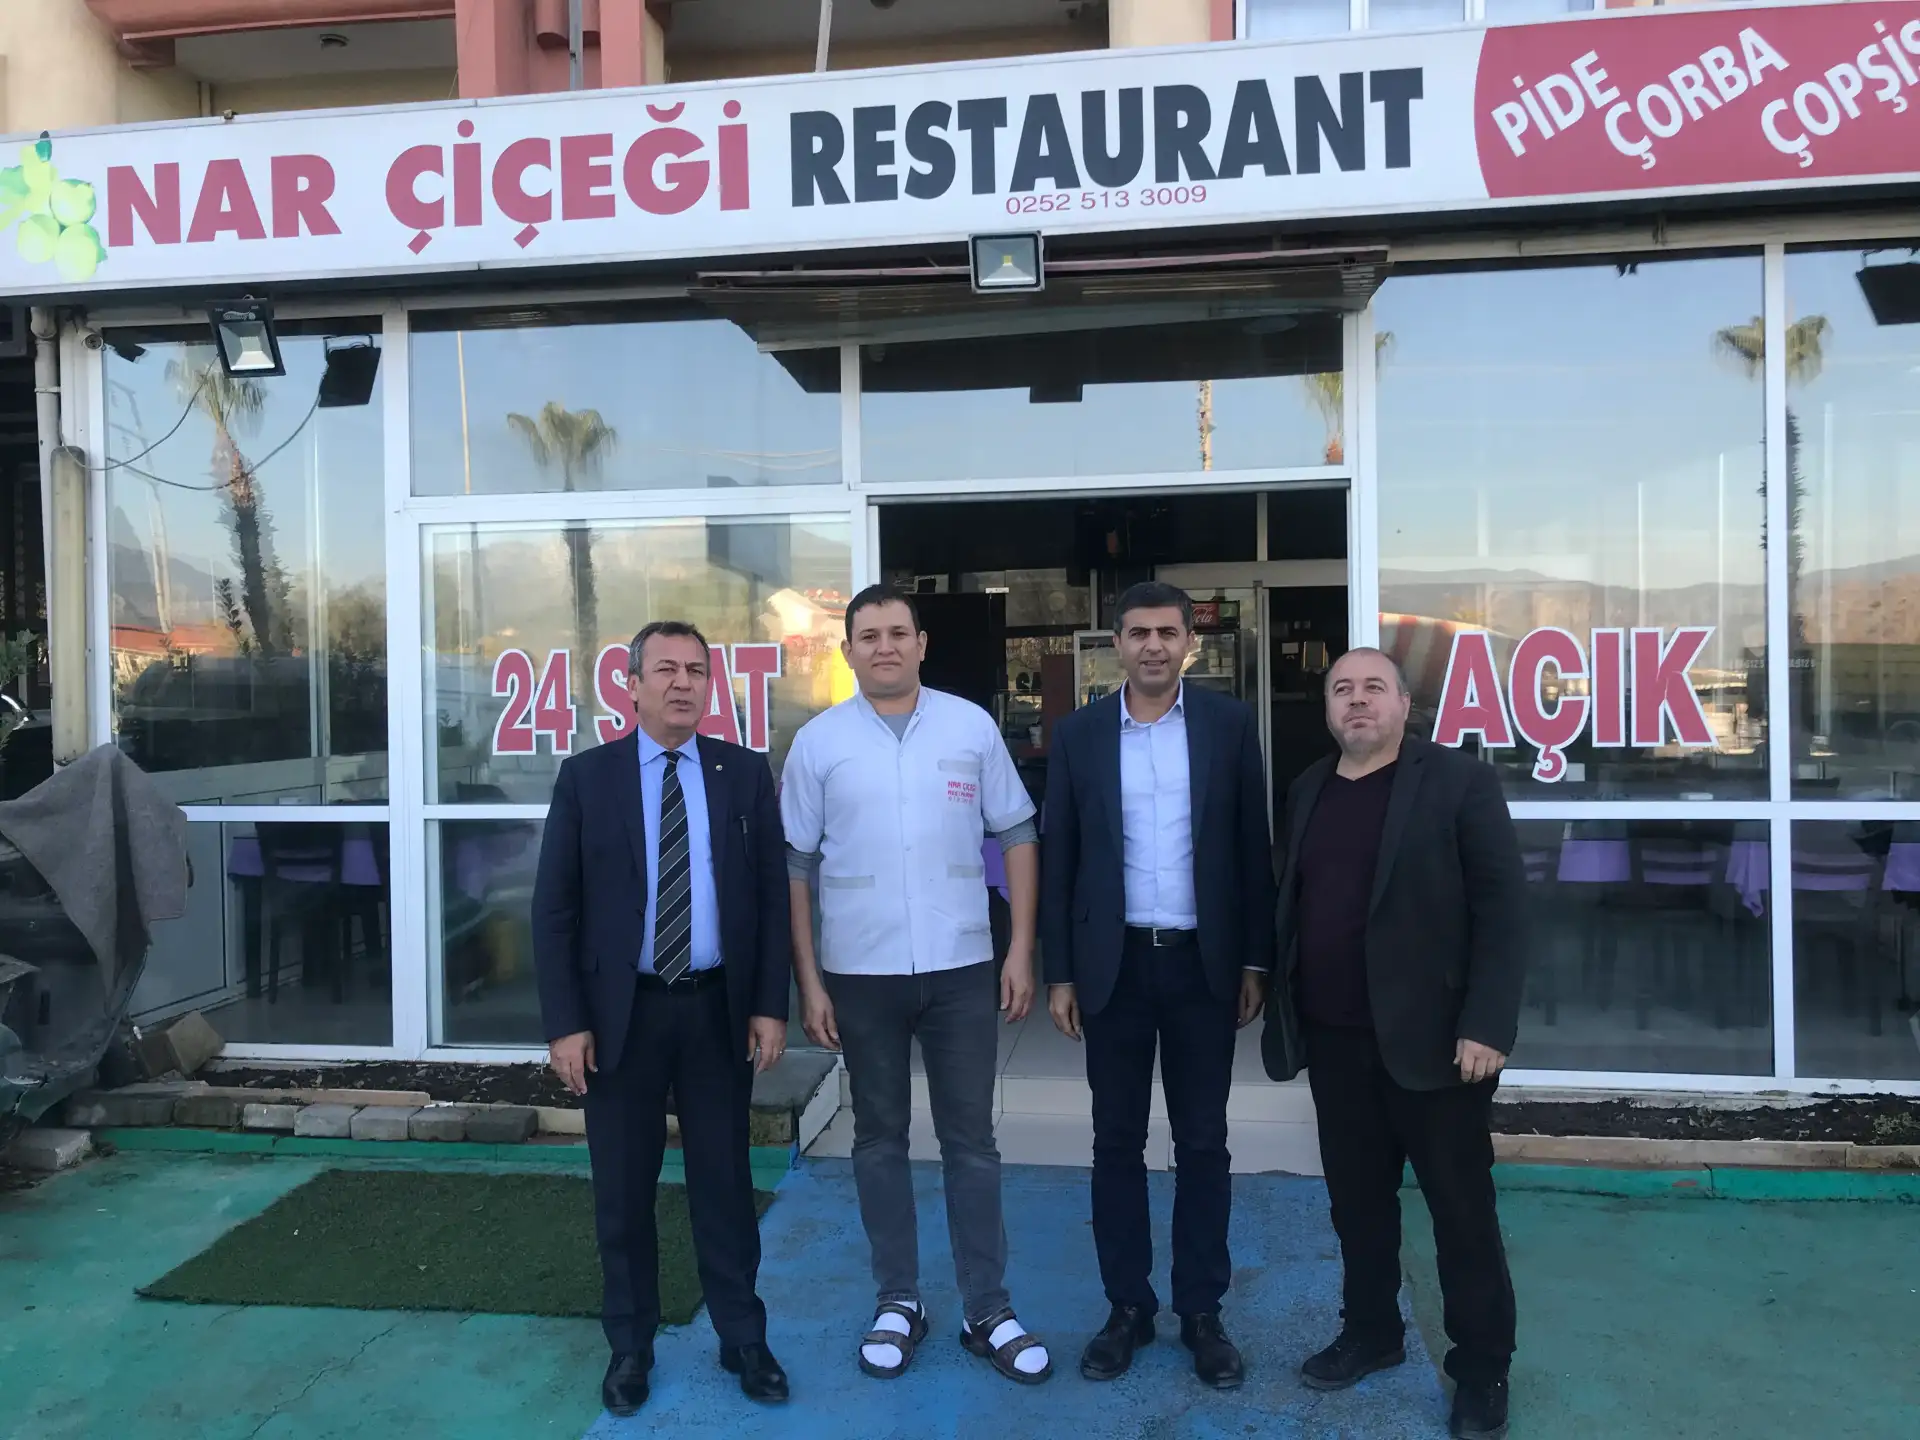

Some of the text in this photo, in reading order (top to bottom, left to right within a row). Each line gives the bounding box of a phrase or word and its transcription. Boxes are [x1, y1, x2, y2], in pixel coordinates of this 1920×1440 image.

[107, 67, 1423, 255] NAR ÇİÇEĞİ RESTAURANT
[1490, 49, 1621, 158] PİDE
[1604, 26, 1791, 171] ÇORBA
[1006, 185, 1207, 215] 0252 513 3009
[492, 643, 782, 755] 24 SAT
[1431, 626, 1719, 783] AÇIK
